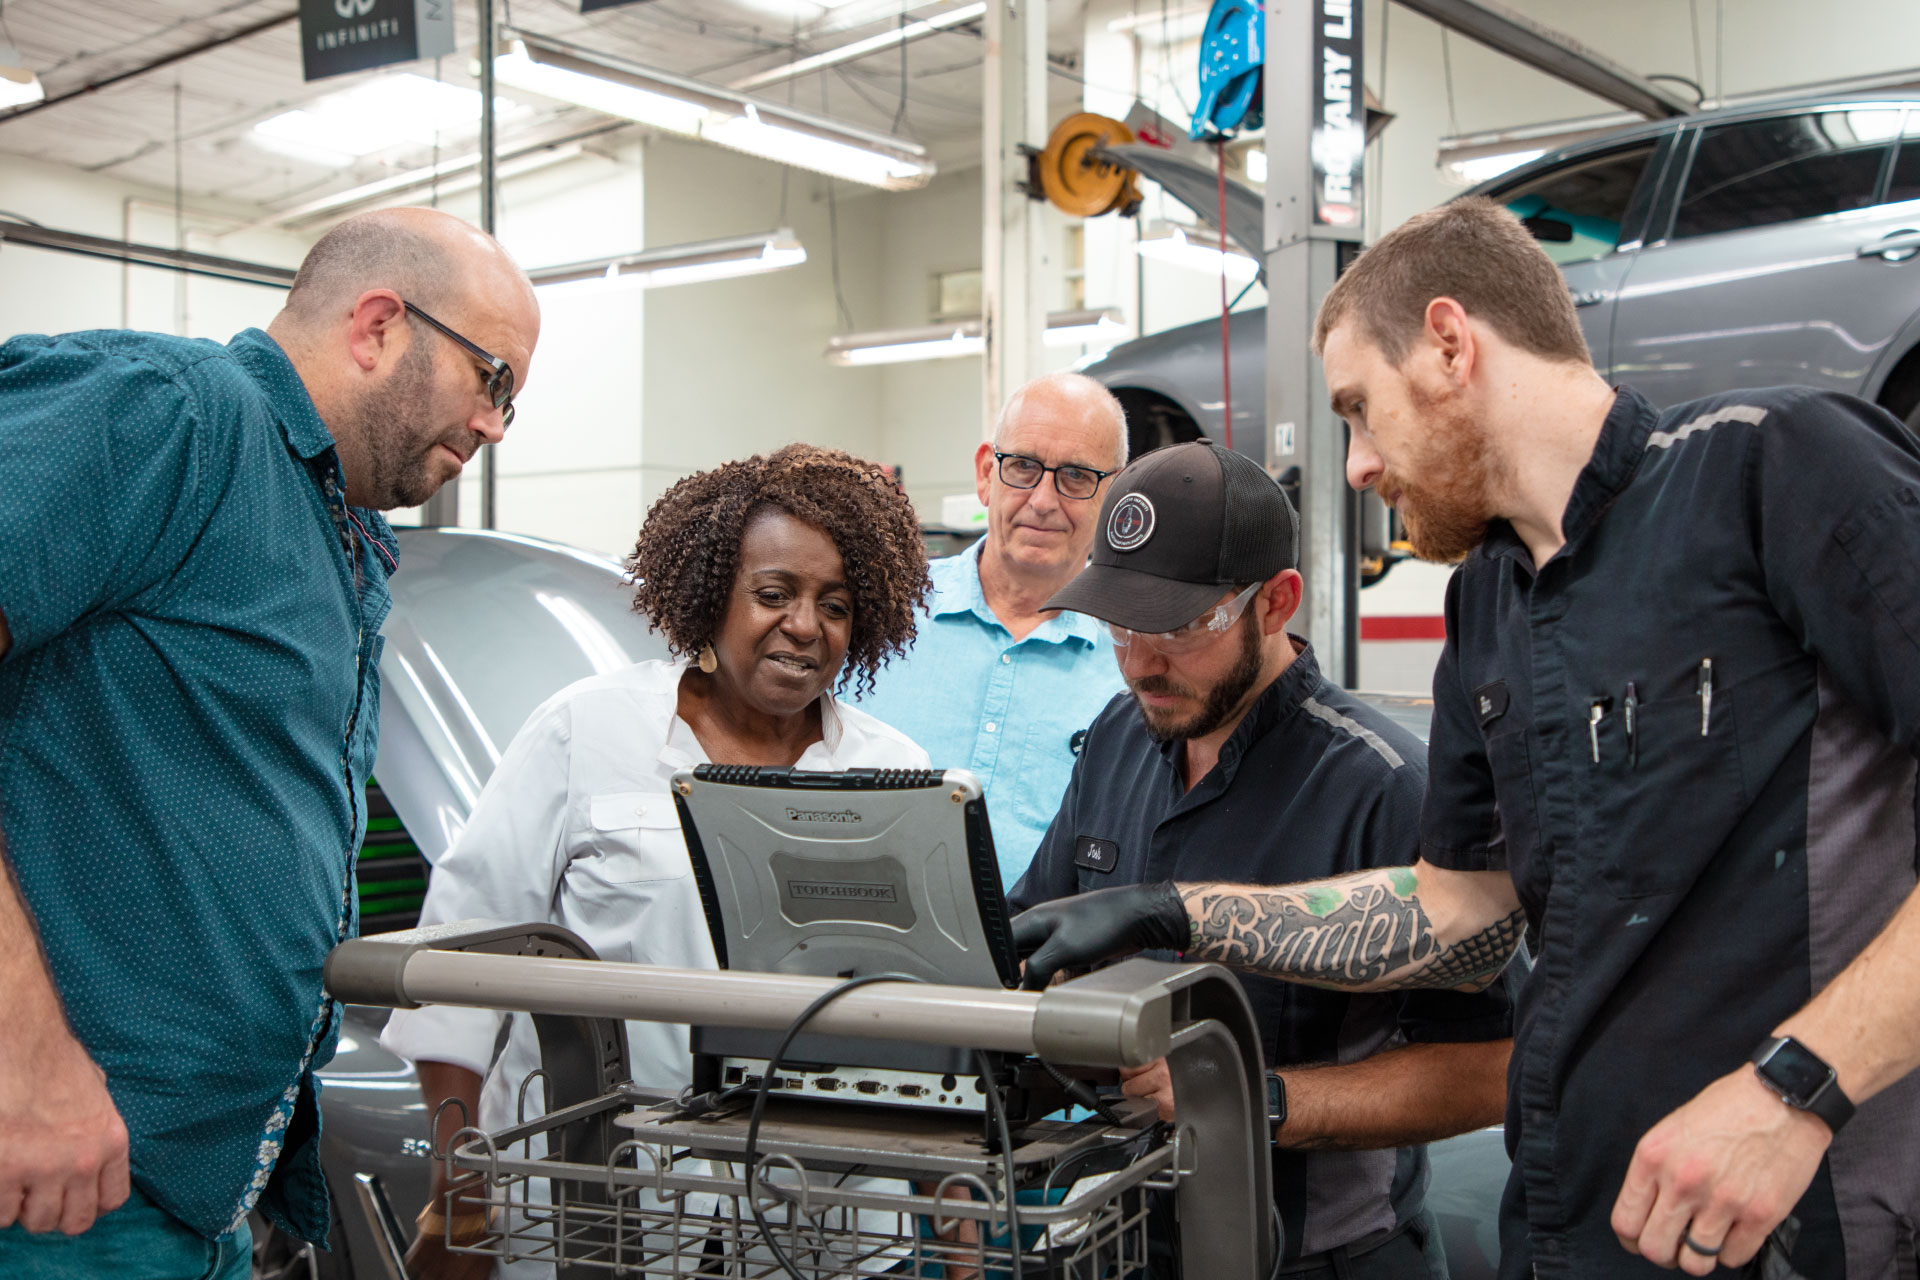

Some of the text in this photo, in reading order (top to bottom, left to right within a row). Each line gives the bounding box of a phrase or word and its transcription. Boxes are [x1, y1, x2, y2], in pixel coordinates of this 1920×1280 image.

[1323, 0, 1352, 39] LI
[317, 18, 398, 50] INFINITI
[785, 808, 862, 823] Panasonic
[793, 885, 892, 898] TOUGHBOOK
